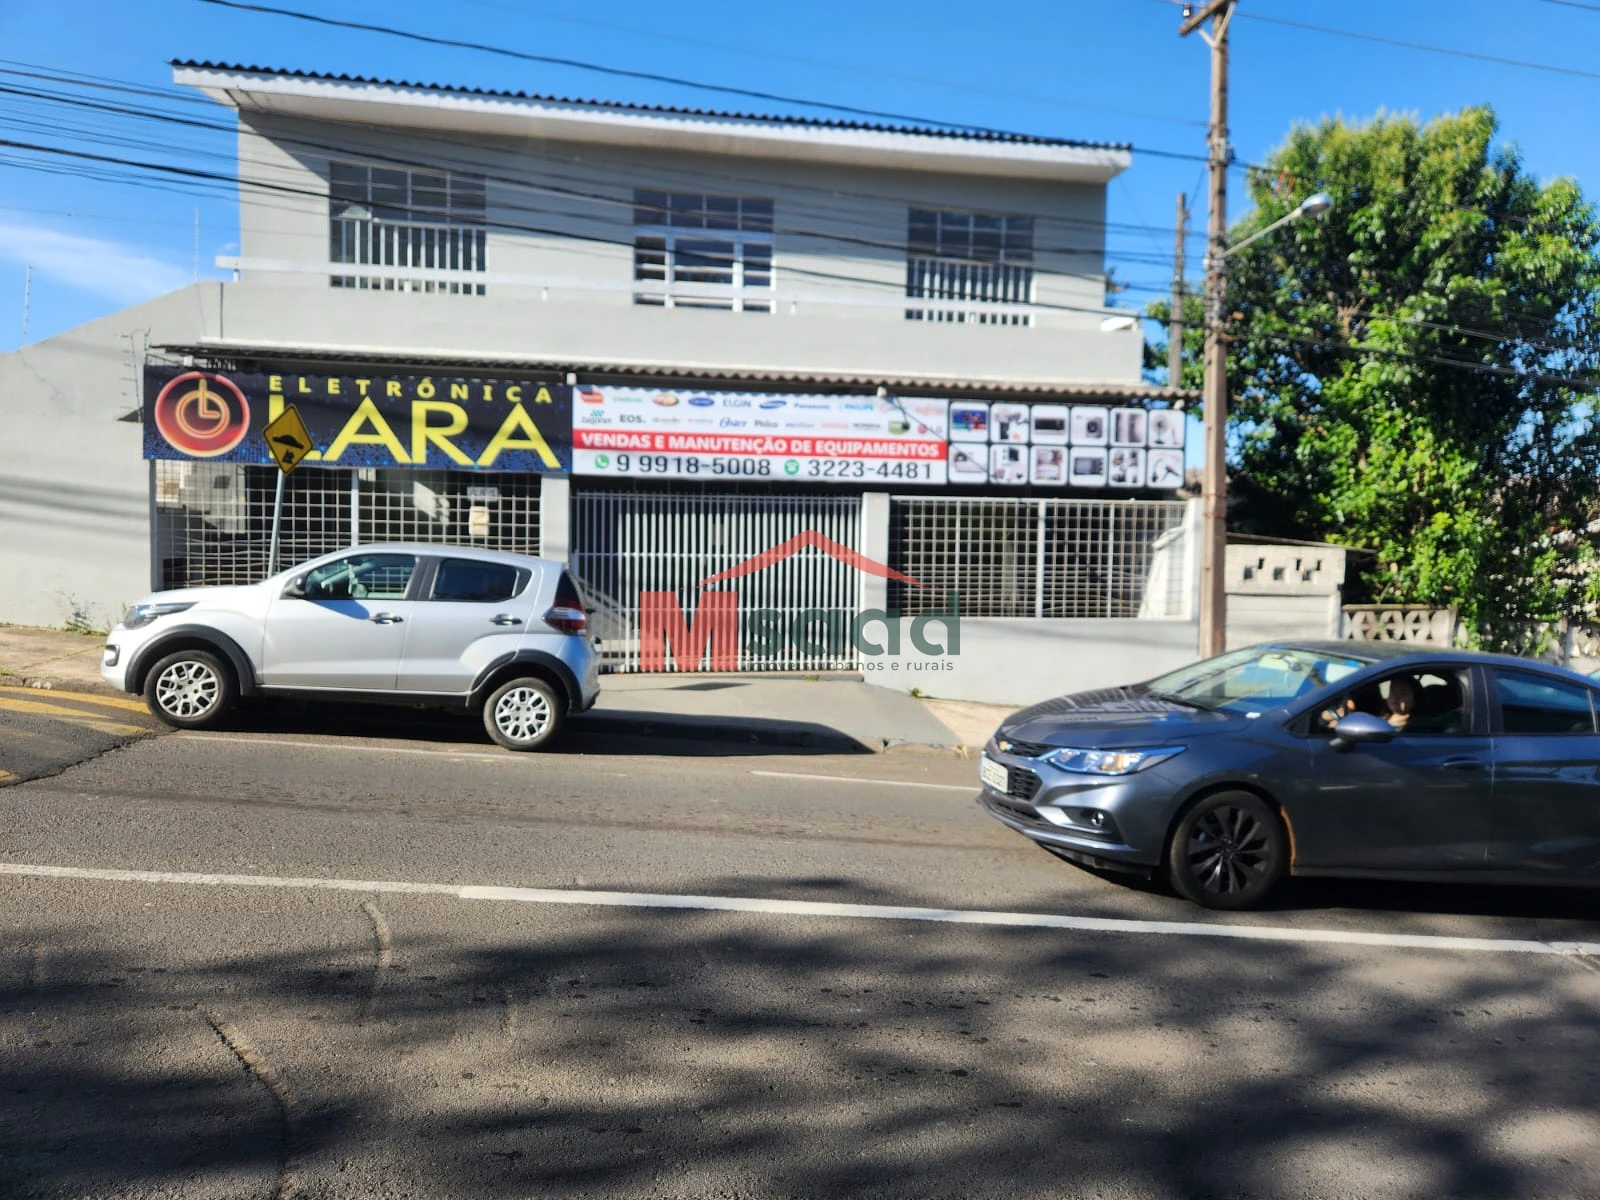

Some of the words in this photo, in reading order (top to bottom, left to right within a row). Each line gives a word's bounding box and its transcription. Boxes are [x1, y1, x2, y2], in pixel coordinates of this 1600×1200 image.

[269, 375, 552, 404] ELETRÔNICA
[723, 396, 751, 407] ELGIN
[581, 432, 650, 448] VENDAS
[655, 435, 665, 448] E
[669, 435, 787, 455] MANUTENÇÃO
[791, 440, 813, 453] DE
[816, 440, 938, 456] EQUIPAMENTOS
[616, 455, 630, 472] 9
[639, 456, 771, 476] 9918-5008
[808, 460, 932, 479] 3223-4481
